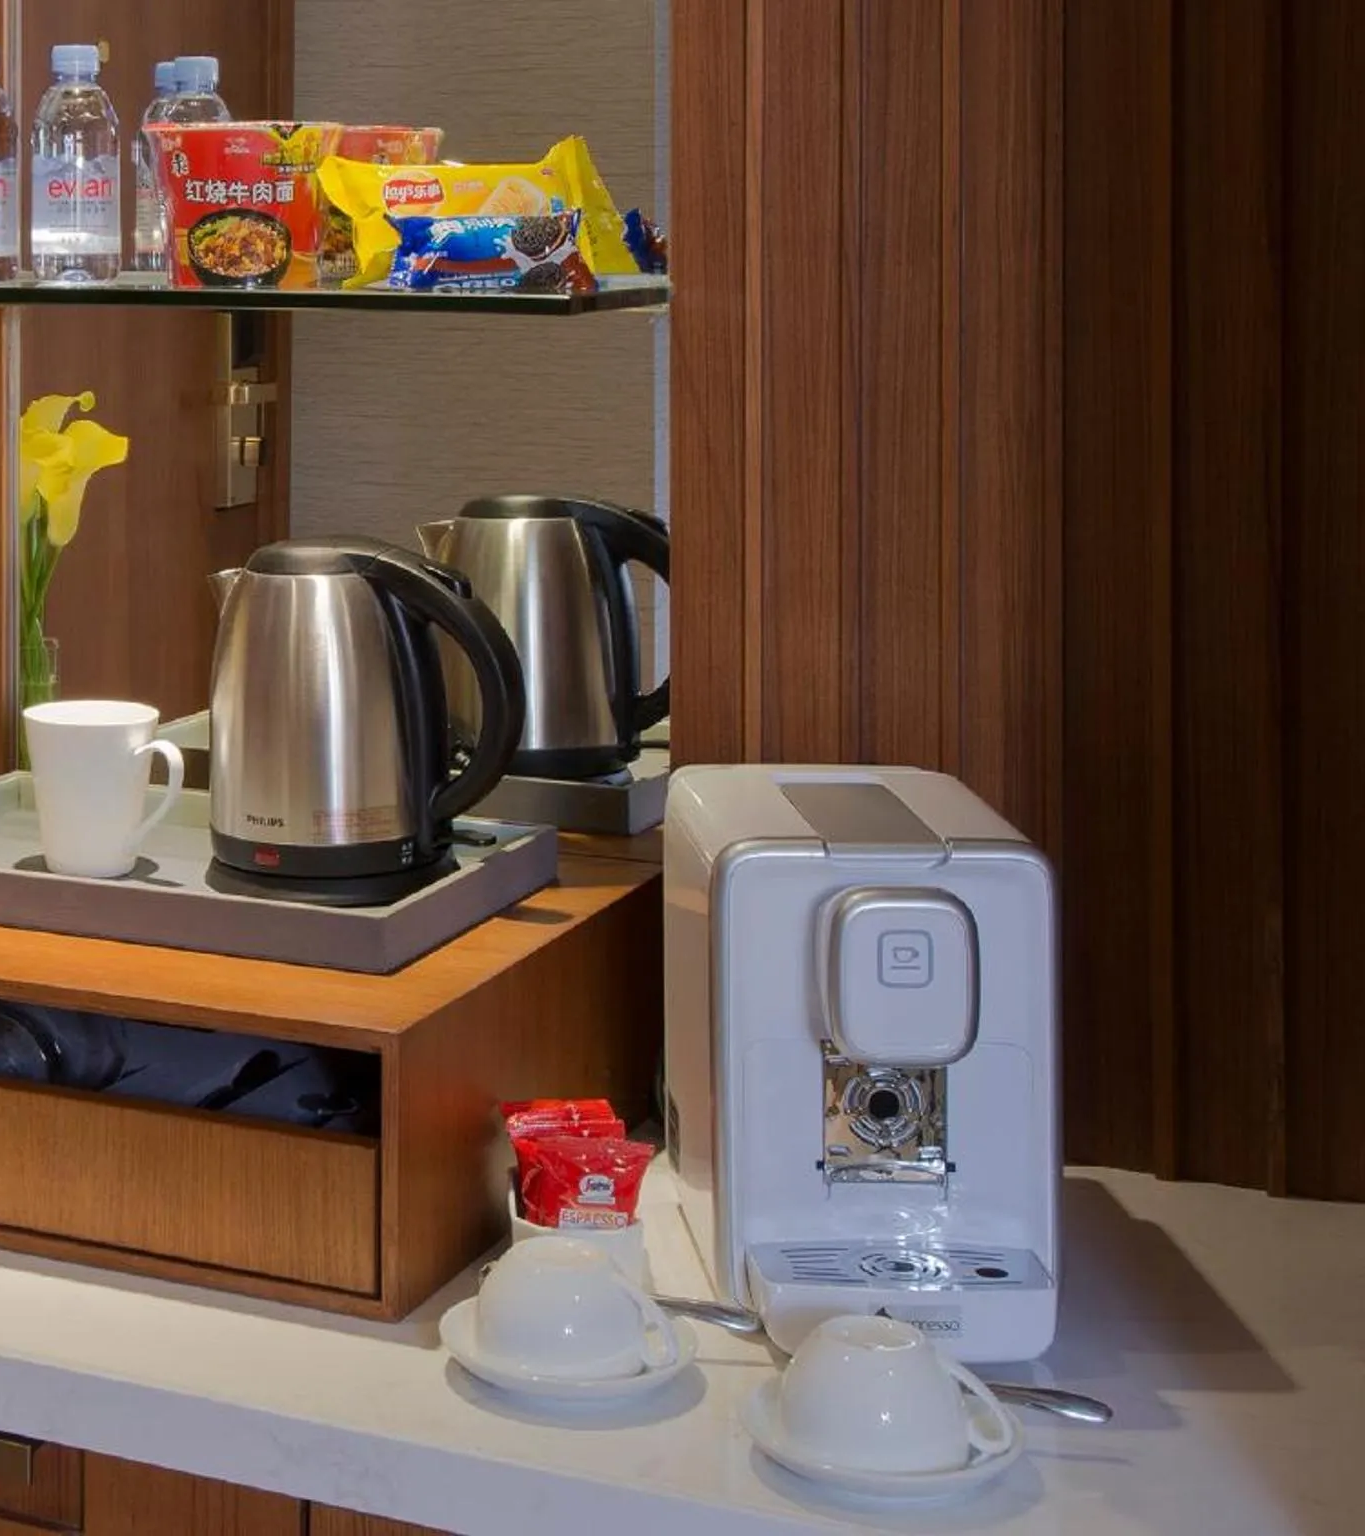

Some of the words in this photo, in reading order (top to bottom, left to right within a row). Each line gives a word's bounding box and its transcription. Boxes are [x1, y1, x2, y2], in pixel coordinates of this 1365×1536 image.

[48, 177, 113, 198] evan
[185, 179, 295, 204] 红烧牛肉面
[246, 814, 285, 828] PHILIPS
[906, 1320, 960, 1331] presso
